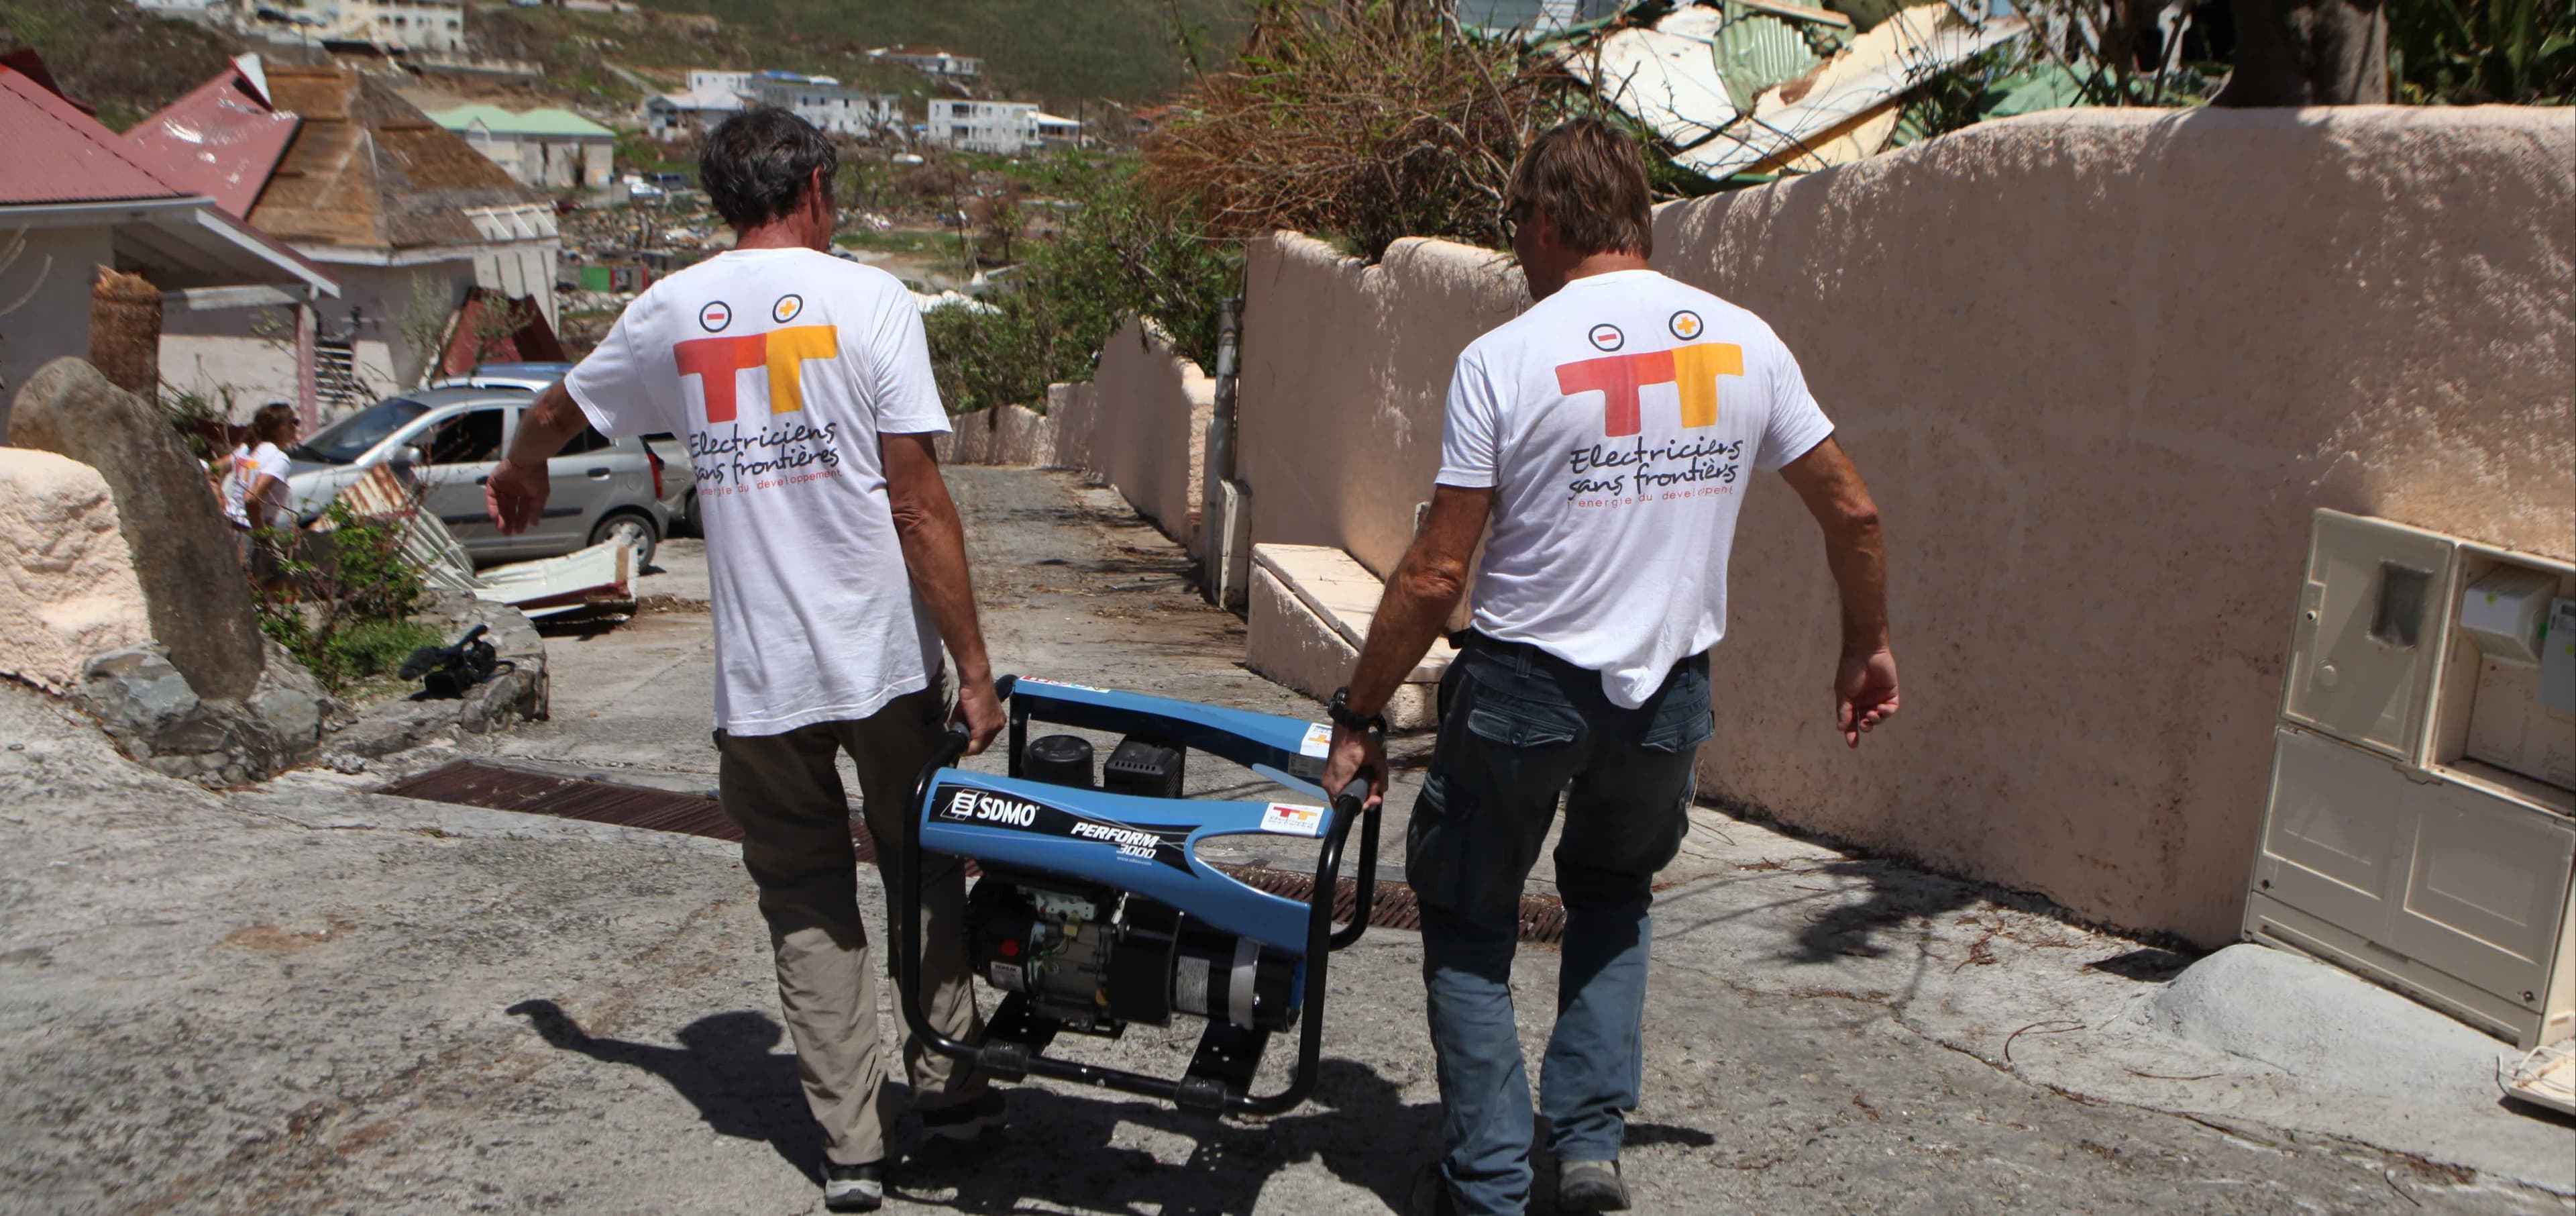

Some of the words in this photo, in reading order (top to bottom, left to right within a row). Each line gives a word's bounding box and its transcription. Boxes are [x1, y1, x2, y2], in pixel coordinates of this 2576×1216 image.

[690, 422, 837, 458] Electriciens
[732, 445, 840, 485] frontières
[1567, 474, 1625, 501] sans
[1633, 456, 1739, 495] frontièrs
[738, 484, 750, 493] du
[1638, 493, 1653, 502] du
[977, 797, 1036, 827] SDMO
[1071, 821, 1161, 848] PERFORM
[1116, 844, 1157, 859] 3000
